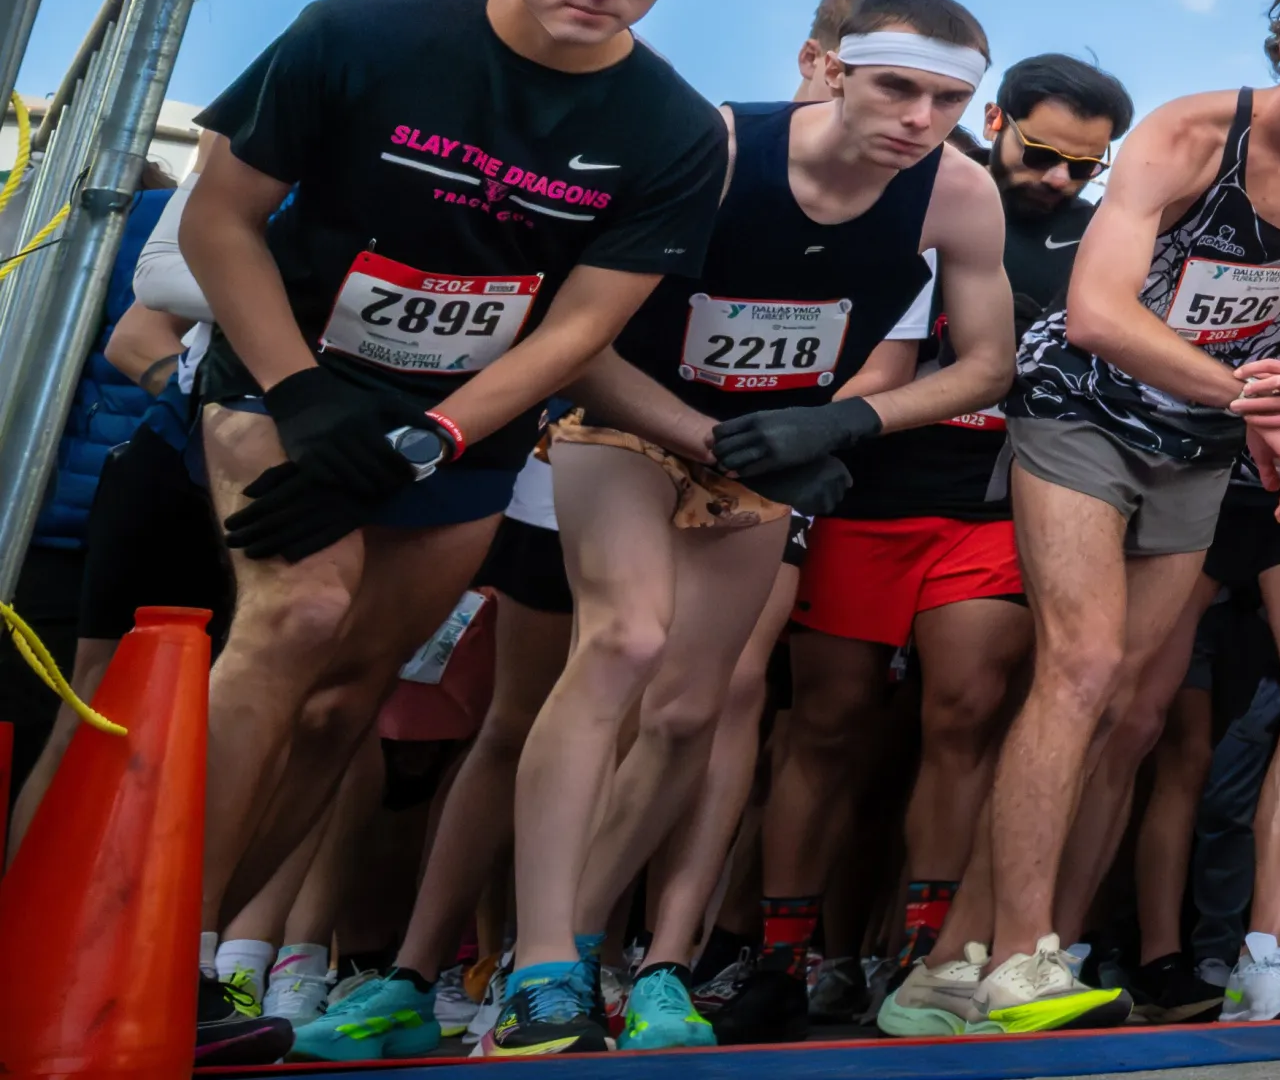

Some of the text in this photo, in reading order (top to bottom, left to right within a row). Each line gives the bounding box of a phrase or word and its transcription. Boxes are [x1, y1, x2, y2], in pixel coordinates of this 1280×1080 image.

[391, 124, 613, 211] SLAY THE DRAGONS
[422, 277, 475, 293] 2025
[361, 285, 505, 337] 5682
[751, 305, 822, 314] DALLAS YMCA
[1185, 293, 1280, 326] 5526
[1205, 329, 1239, 341] 2025
[703, 334, 821, 369] 2218
[734, 376, 779, 388] 2025
